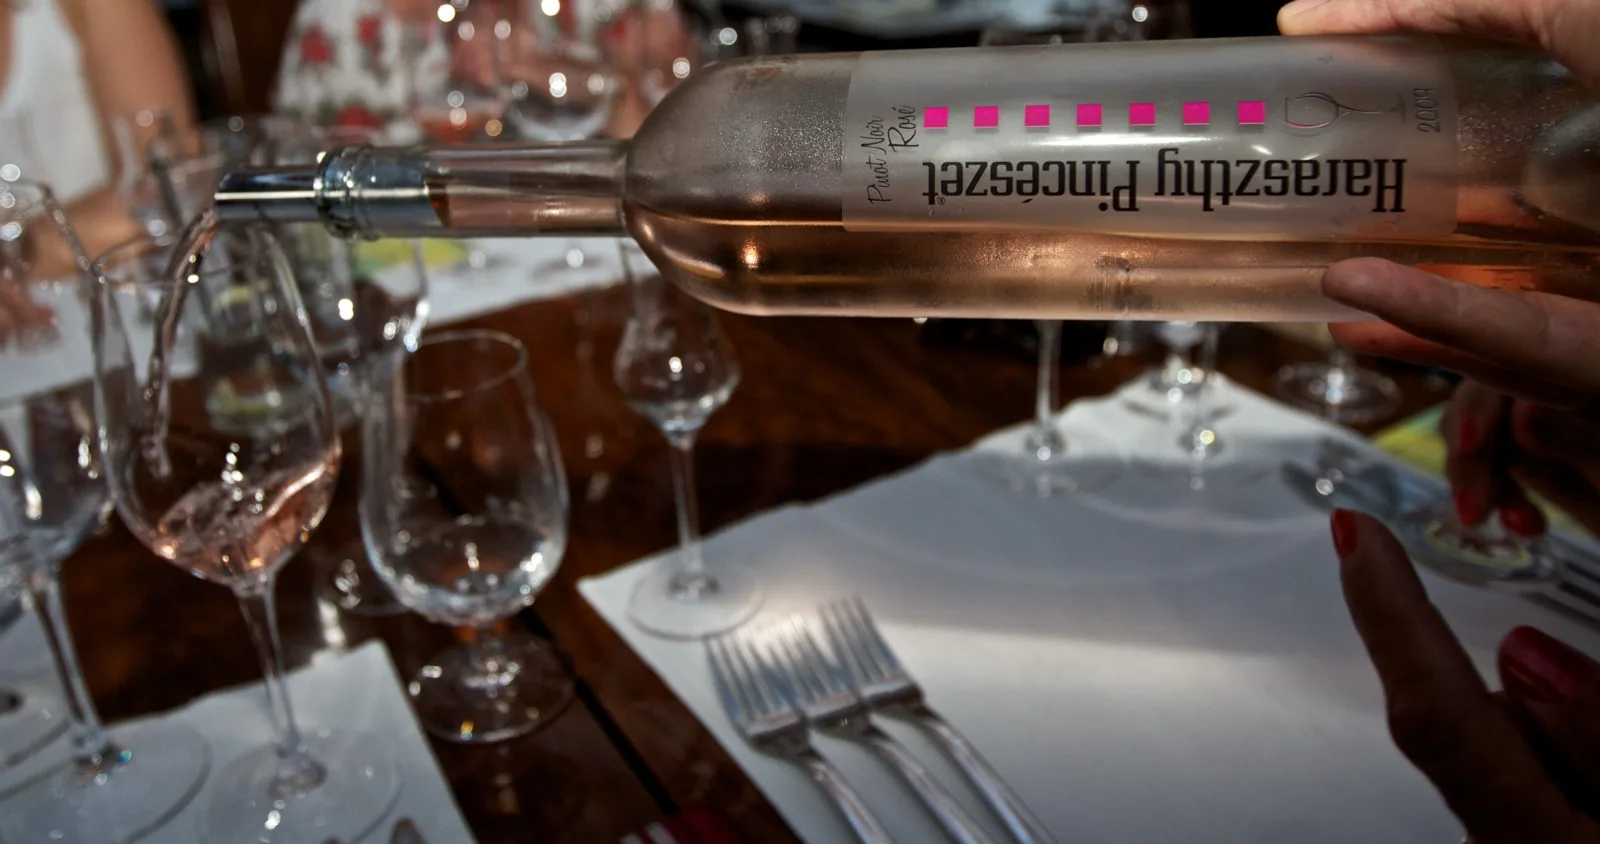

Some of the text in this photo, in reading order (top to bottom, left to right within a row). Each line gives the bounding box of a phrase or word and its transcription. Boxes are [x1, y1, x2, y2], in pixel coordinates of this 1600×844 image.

[887, 105, 919, 152] Rosé
[1413, 87, 1441, 133] 2009
[860, 116, 892, 204] Pinot Noir
[922, 147, 1407, 212] Haraszthy Pincészet
